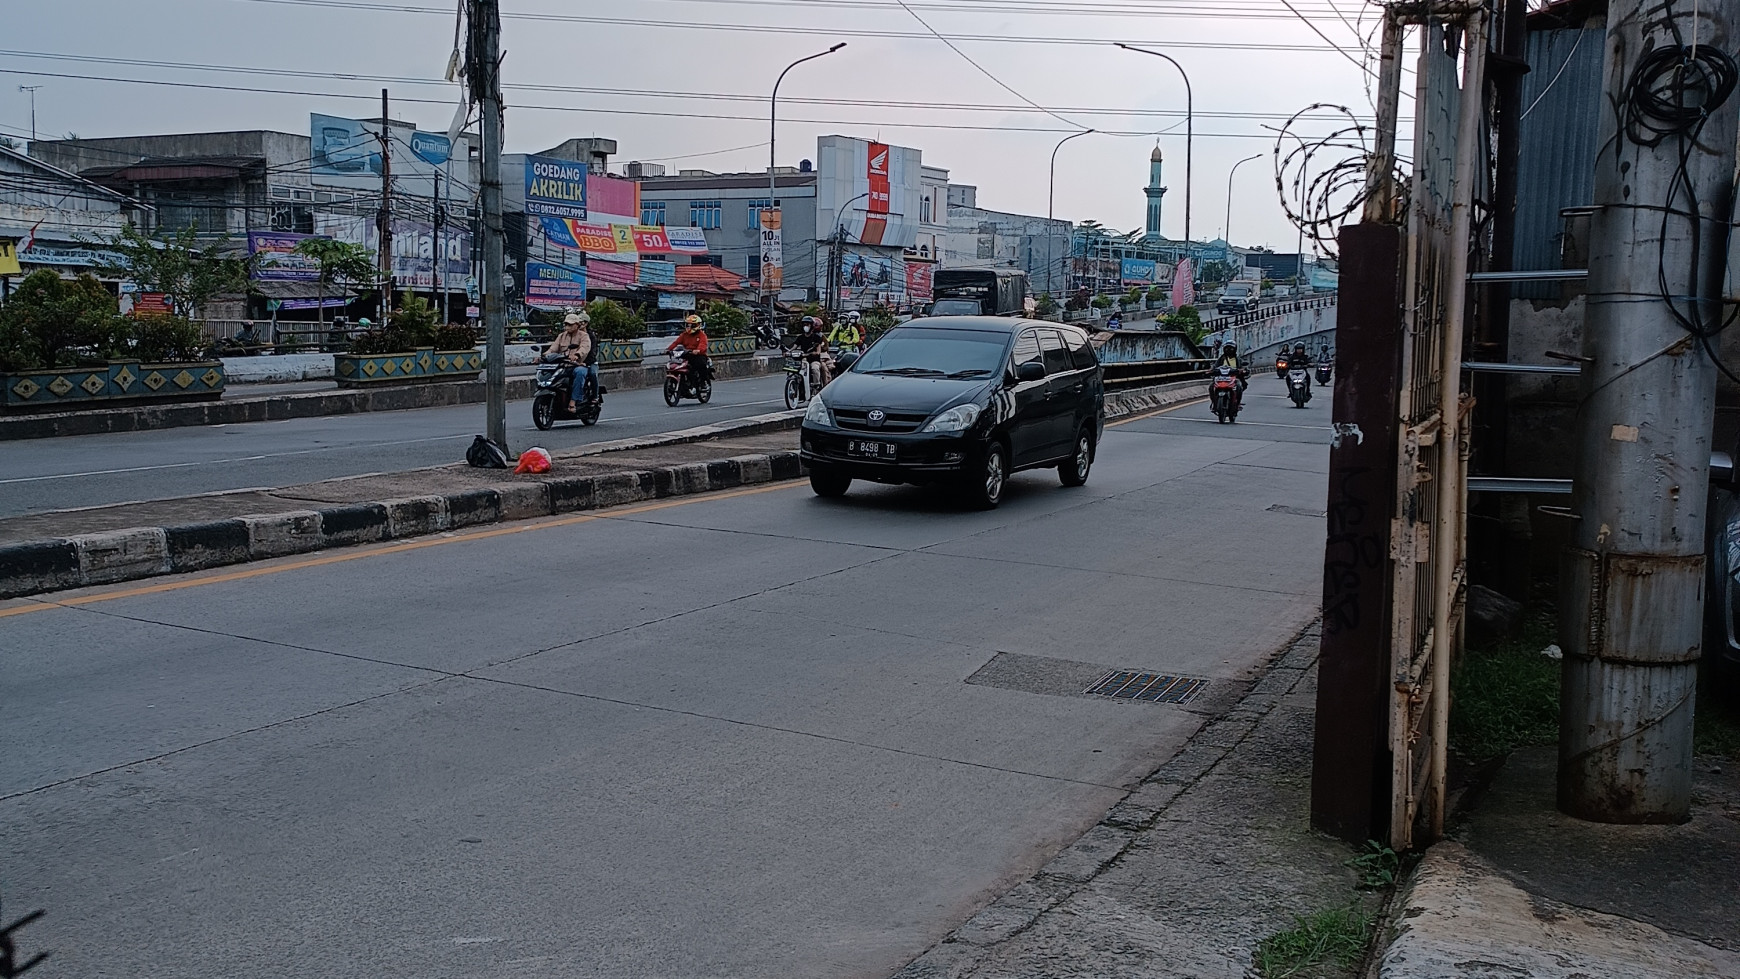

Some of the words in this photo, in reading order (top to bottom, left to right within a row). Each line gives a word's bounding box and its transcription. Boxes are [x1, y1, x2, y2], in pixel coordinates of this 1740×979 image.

[413, 139, 449, 153] Quantum
[533, 162, 580, 181] GOEDANG
[530, 177, 583, 202] AKRILIK
[540, 204, 585, 218] 0822.6057.9995
[576, 227, 613, 237] PARADISE
[619, 230, 628, 240] 2
[762, 231, 774, 241] 10
[580, 235, 615, 250] BBQ
[643, 234, 663, 247] 50
[763, 252, 769, 262] 6
[539, 267, 573, 280] MENJUAL
[849, 441, 854, 451] B
[860, 442, 878, 452] 8498
[886, 444, 895, 454] TB
